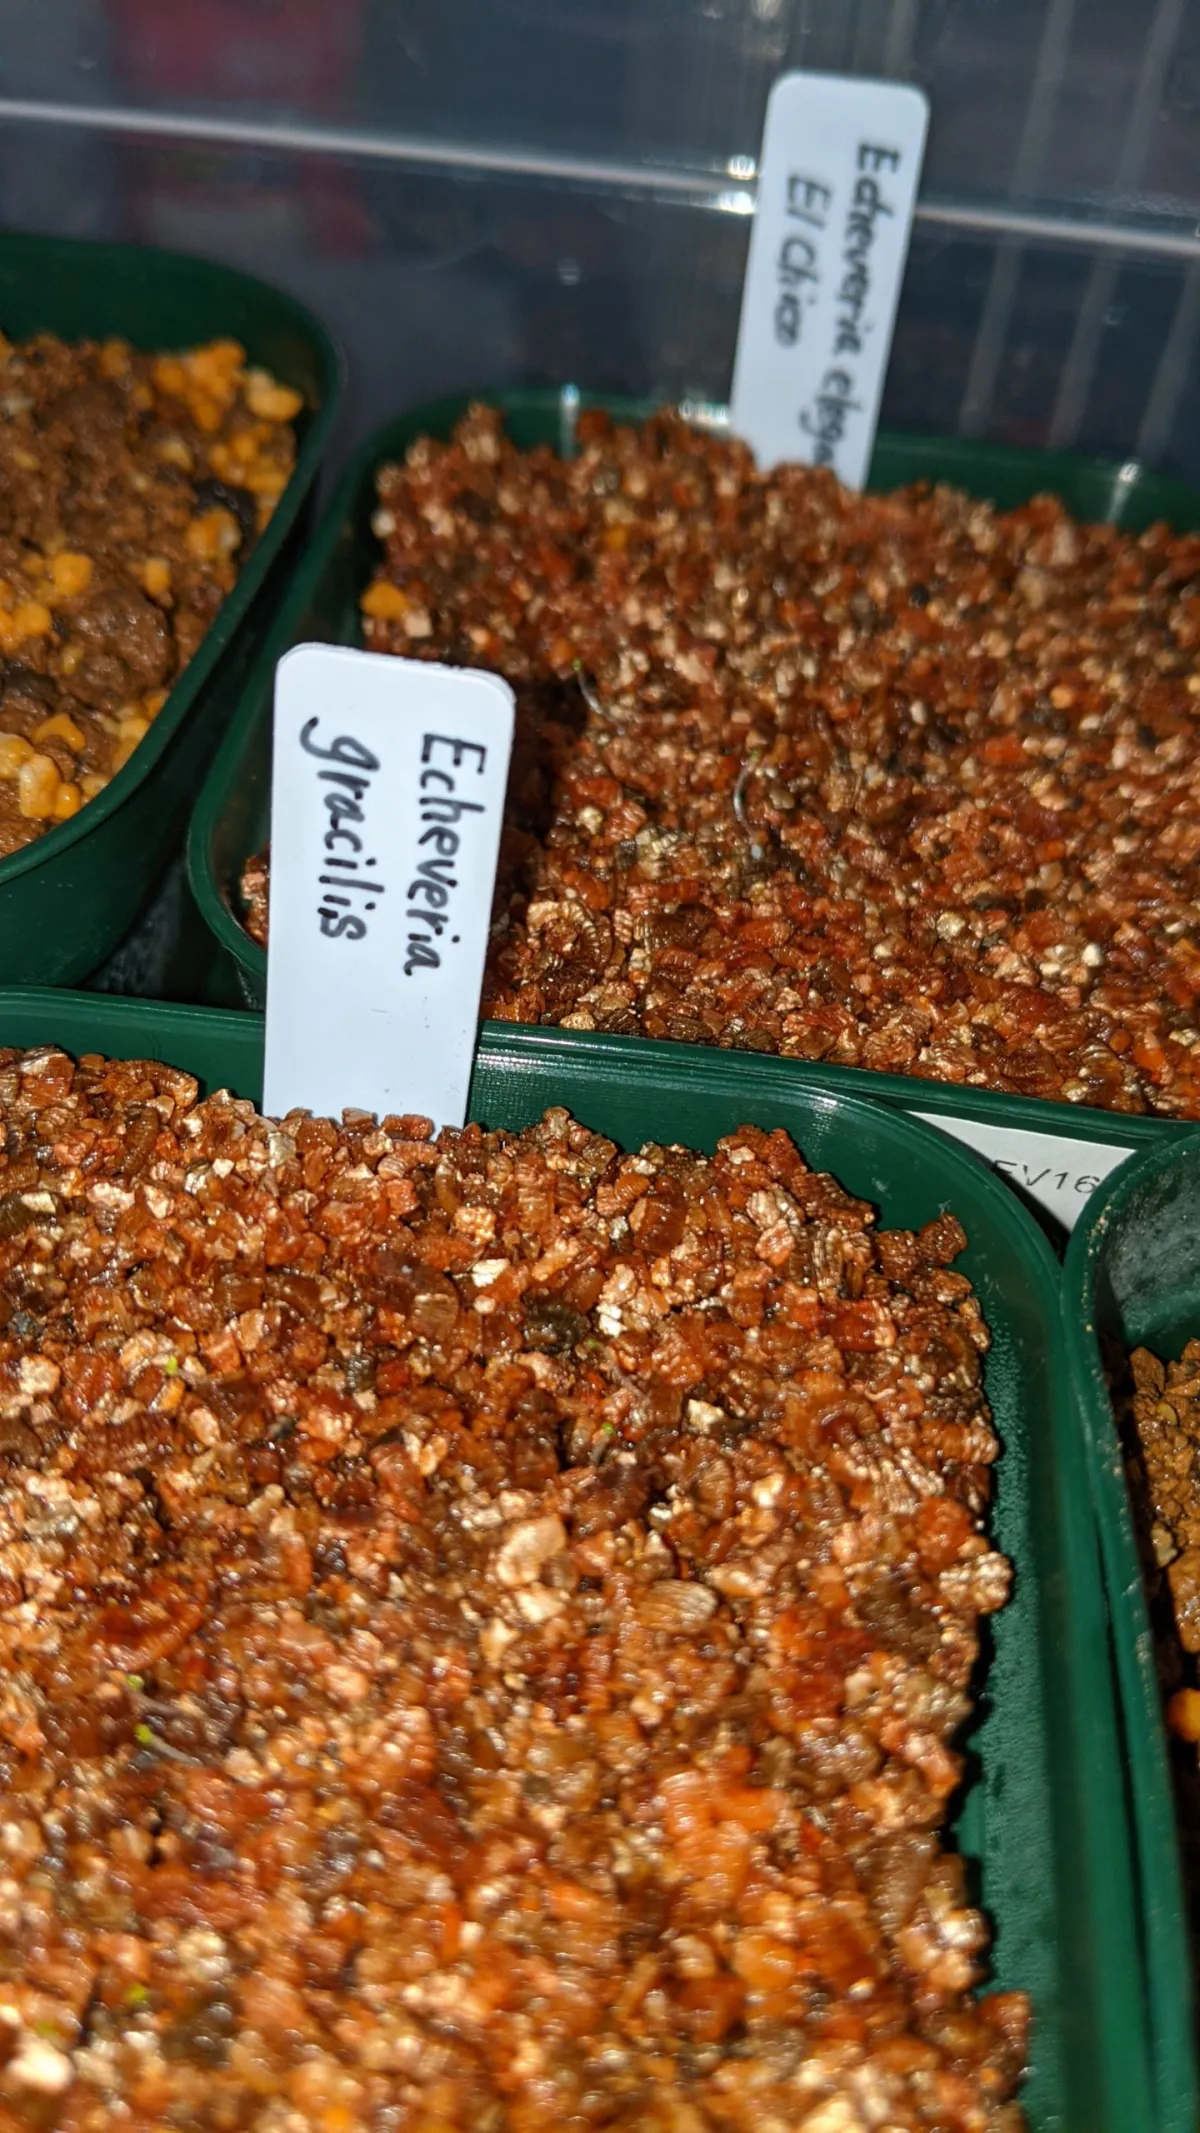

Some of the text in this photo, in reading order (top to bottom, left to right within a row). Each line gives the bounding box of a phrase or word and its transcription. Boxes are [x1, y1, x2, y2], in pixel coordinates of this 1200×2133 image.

[785, 173, 832, 231] El
[833, 140, 901, 356] Echeveria
[300, 716, 385, 940] gracilis
[404, 732, 488, 977] Echeveria
